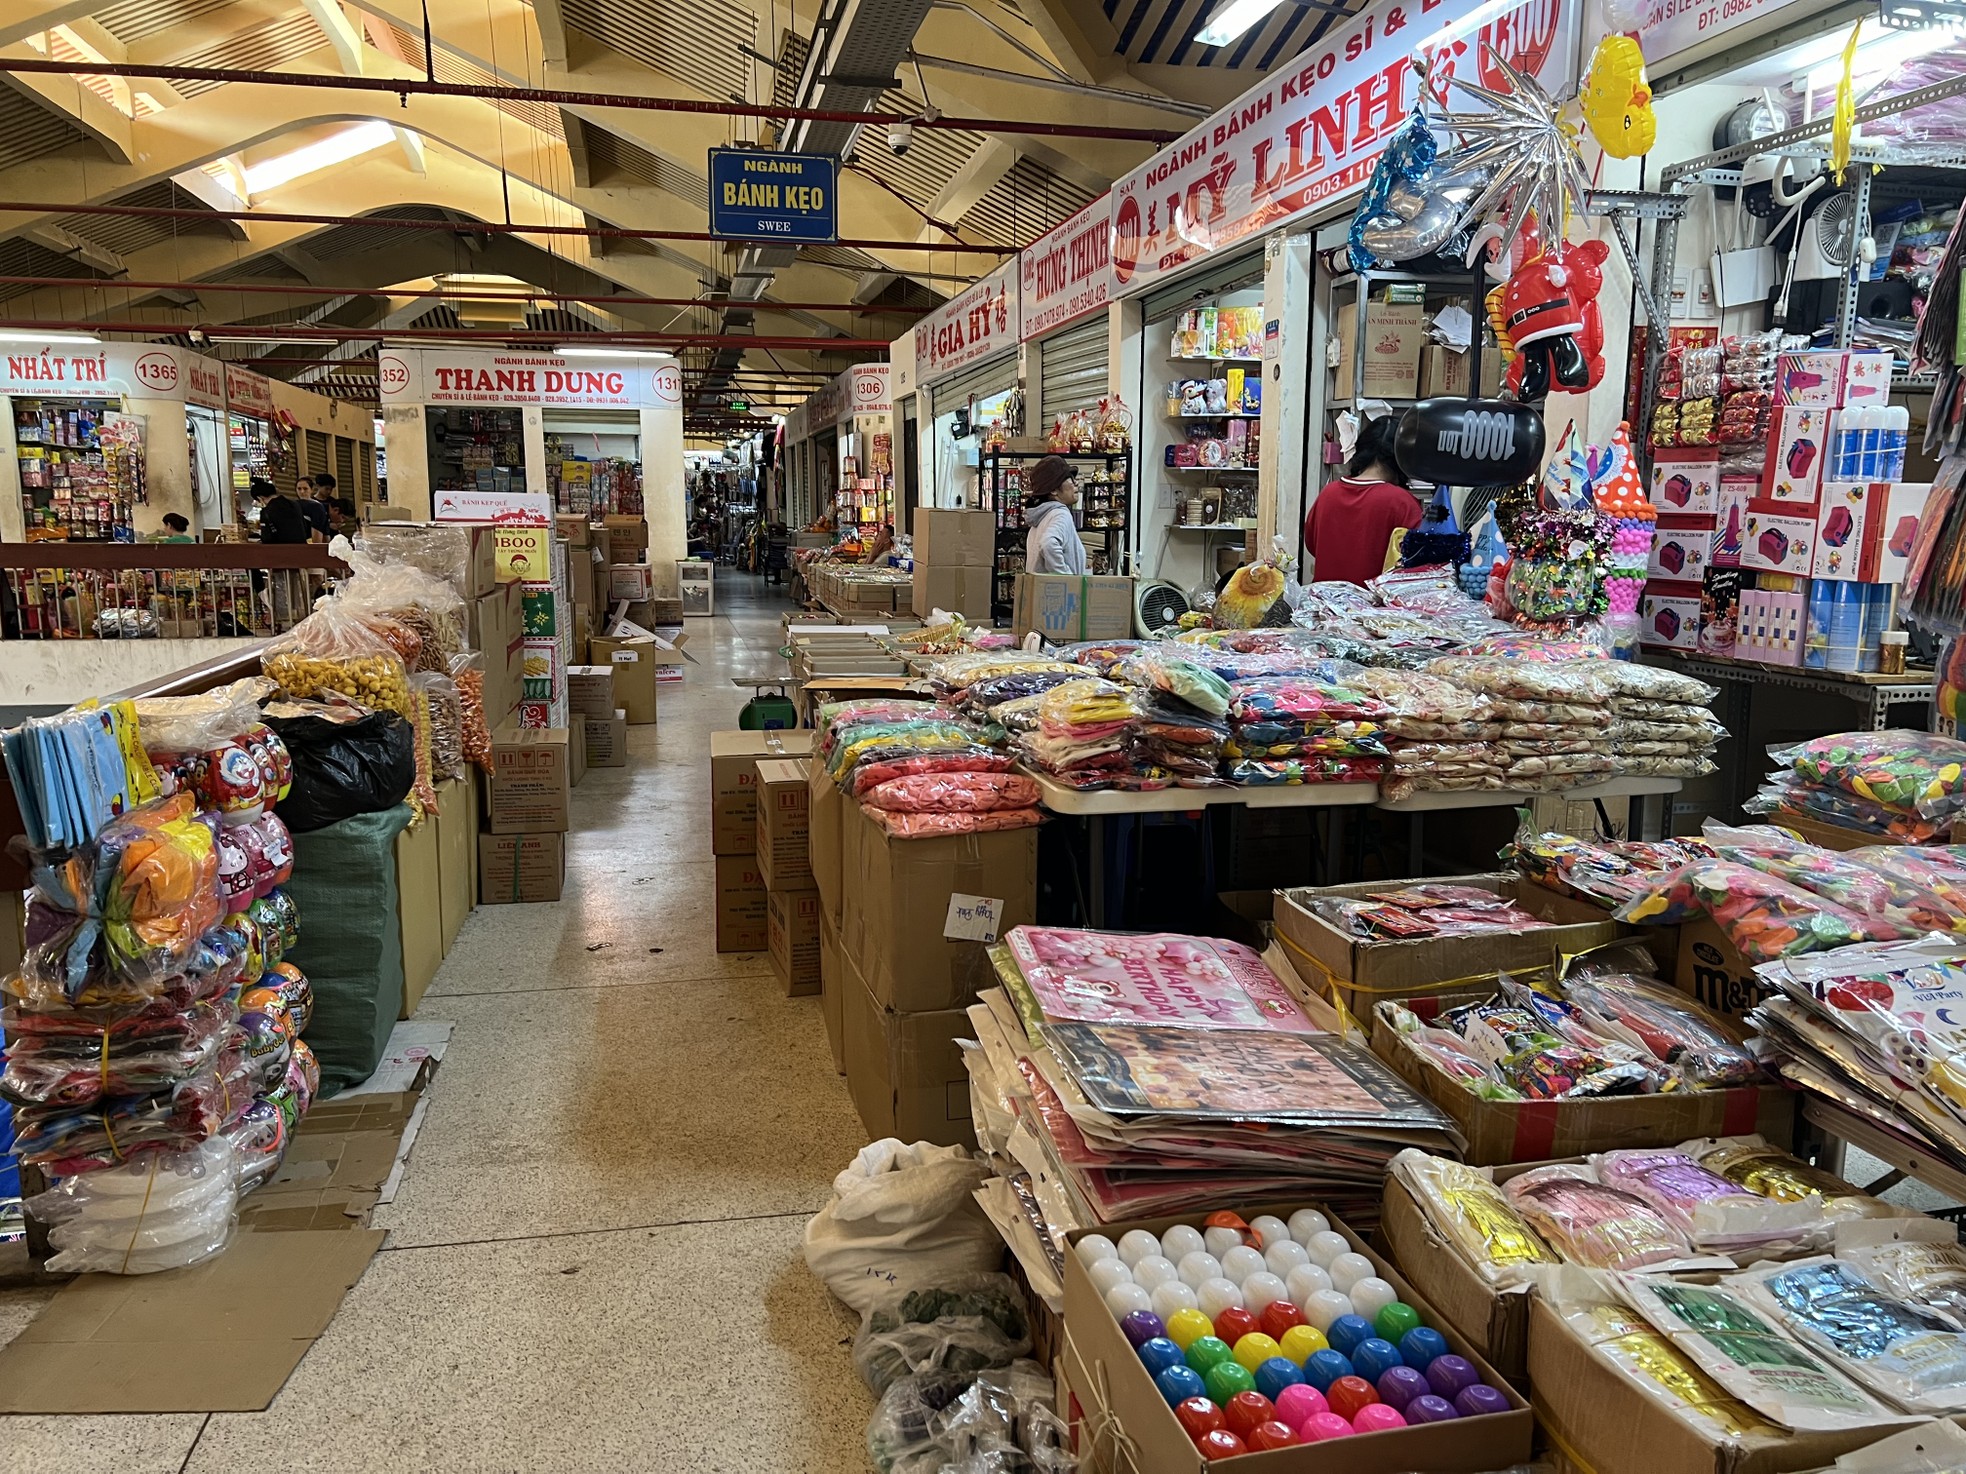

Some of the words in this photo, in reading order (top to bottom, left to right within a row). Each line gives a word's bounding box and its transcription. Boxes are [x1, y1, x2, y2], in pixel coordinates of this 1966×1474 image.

[1698, 7, 1719, 31] ĐT:
[1146, 136, 1207, 190] NGÀNH
[1213, 92, 1273, 148] BÁNH
[1281, 52, 1336, 105] KẸO
[1251, 53, 1413, 204] LINH
[744, 160, 803, 174] NGÀNH
[723, 178, 779, 208] BÁNH
[785, 185, 824, 214] KẸO
[757, 220, 791, 232] SWEE
[1035, 244, 1067, 303] HƯNG
[1070, 215, 1110, 289] THỊNH
[938, 319, 965, 358] GIA
[8, 345, 66, 381] NHẤT
[71, 350, 108, 382] TRÍ
[138, 363, 177, 380] 1365
[494, 356, 523, 366] NGÀNH
[525, 357, 548, 366] BÁNH
[549, 358, 566, 367] KẸO
[435, 368, 536, 392] THANH
[544, 371, 624, 394] DUNG
[856, 383, 880, 394] 1306
[1460, 410, 1516, 461] 1000
[1122, 957, 1186, 1019] BIRTHDAY
[1158, 966, 1210, 1016] HAPPY
